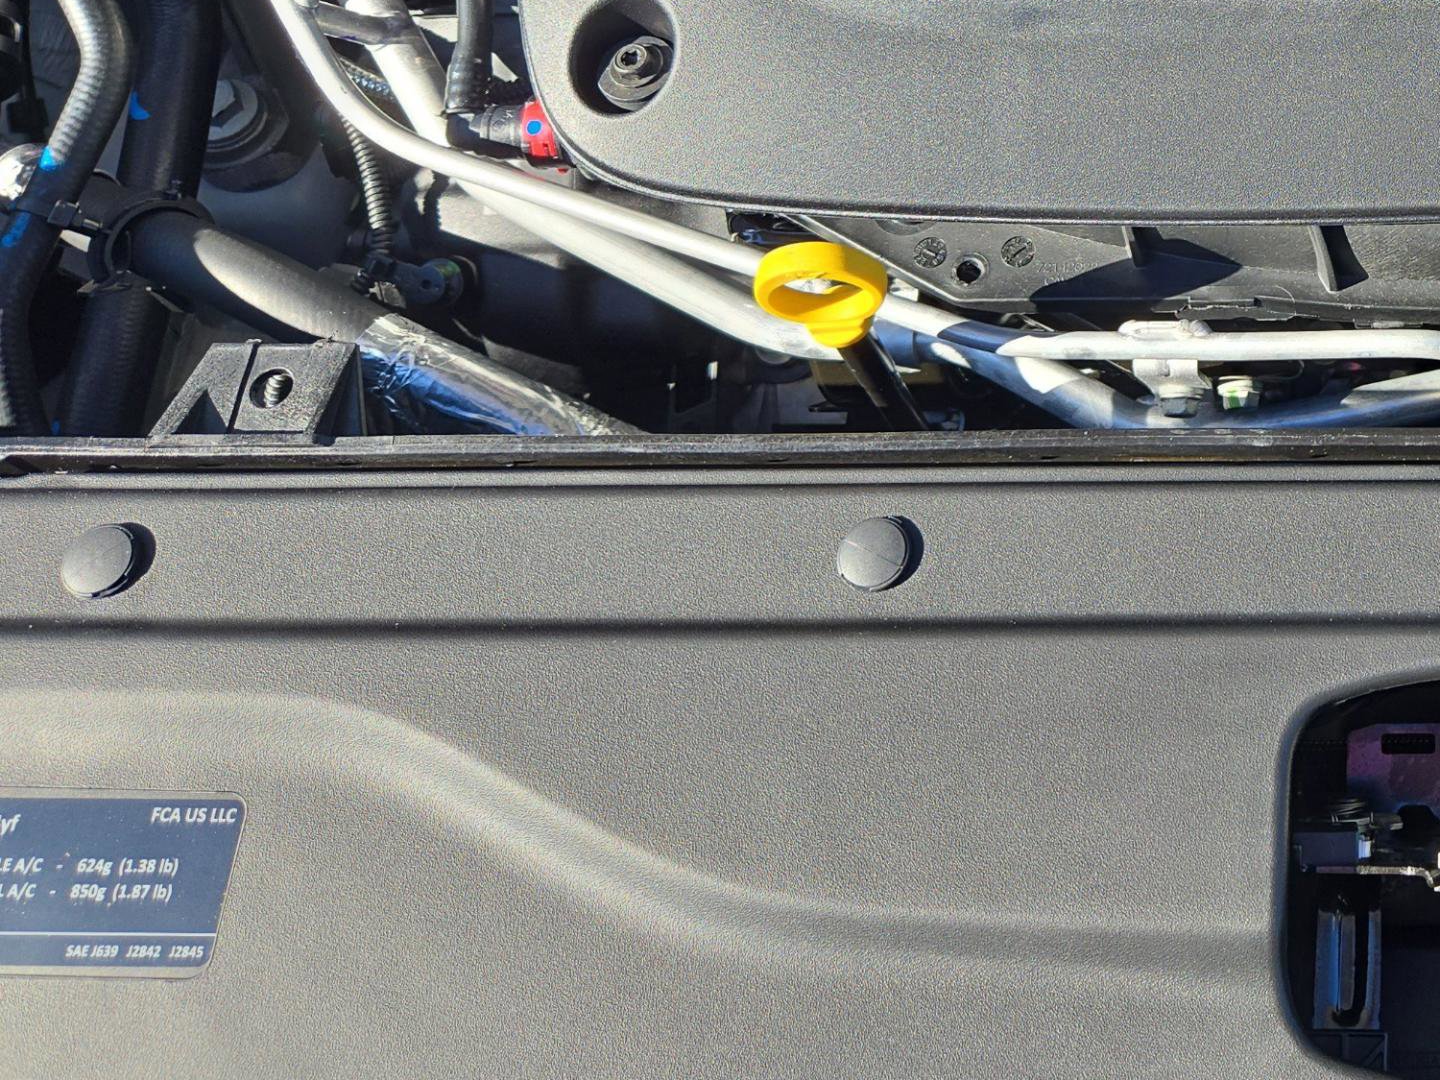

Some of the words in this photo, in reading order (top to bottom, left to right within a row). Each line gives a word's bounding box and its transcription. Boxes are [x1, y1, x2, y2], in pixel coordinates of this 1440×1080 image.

[0, 813, 21, 837] yf
[151, 807, 180, 824] FCA
[185, 807, 208, 823] US
[210, 807, 238, 823] LLC
[13, 856, 44, 875] A/C
[77, 858, 113, 876] 624g
[119, 857, 157, 877] (1.38
[158, 858, 179, 878] lb)
[6, 882, 37, 901] A/C
[70, 883, 107, 902] 850g
[112, 883, 151, 903] (1.87
[152, 883, 172, 903] lb)
[65, 944, 90, 959] SAE
[90, 944, 119, 960] J639
[125, 944, 162, 960] J2842
[168, 944, 205, 960] J2845
